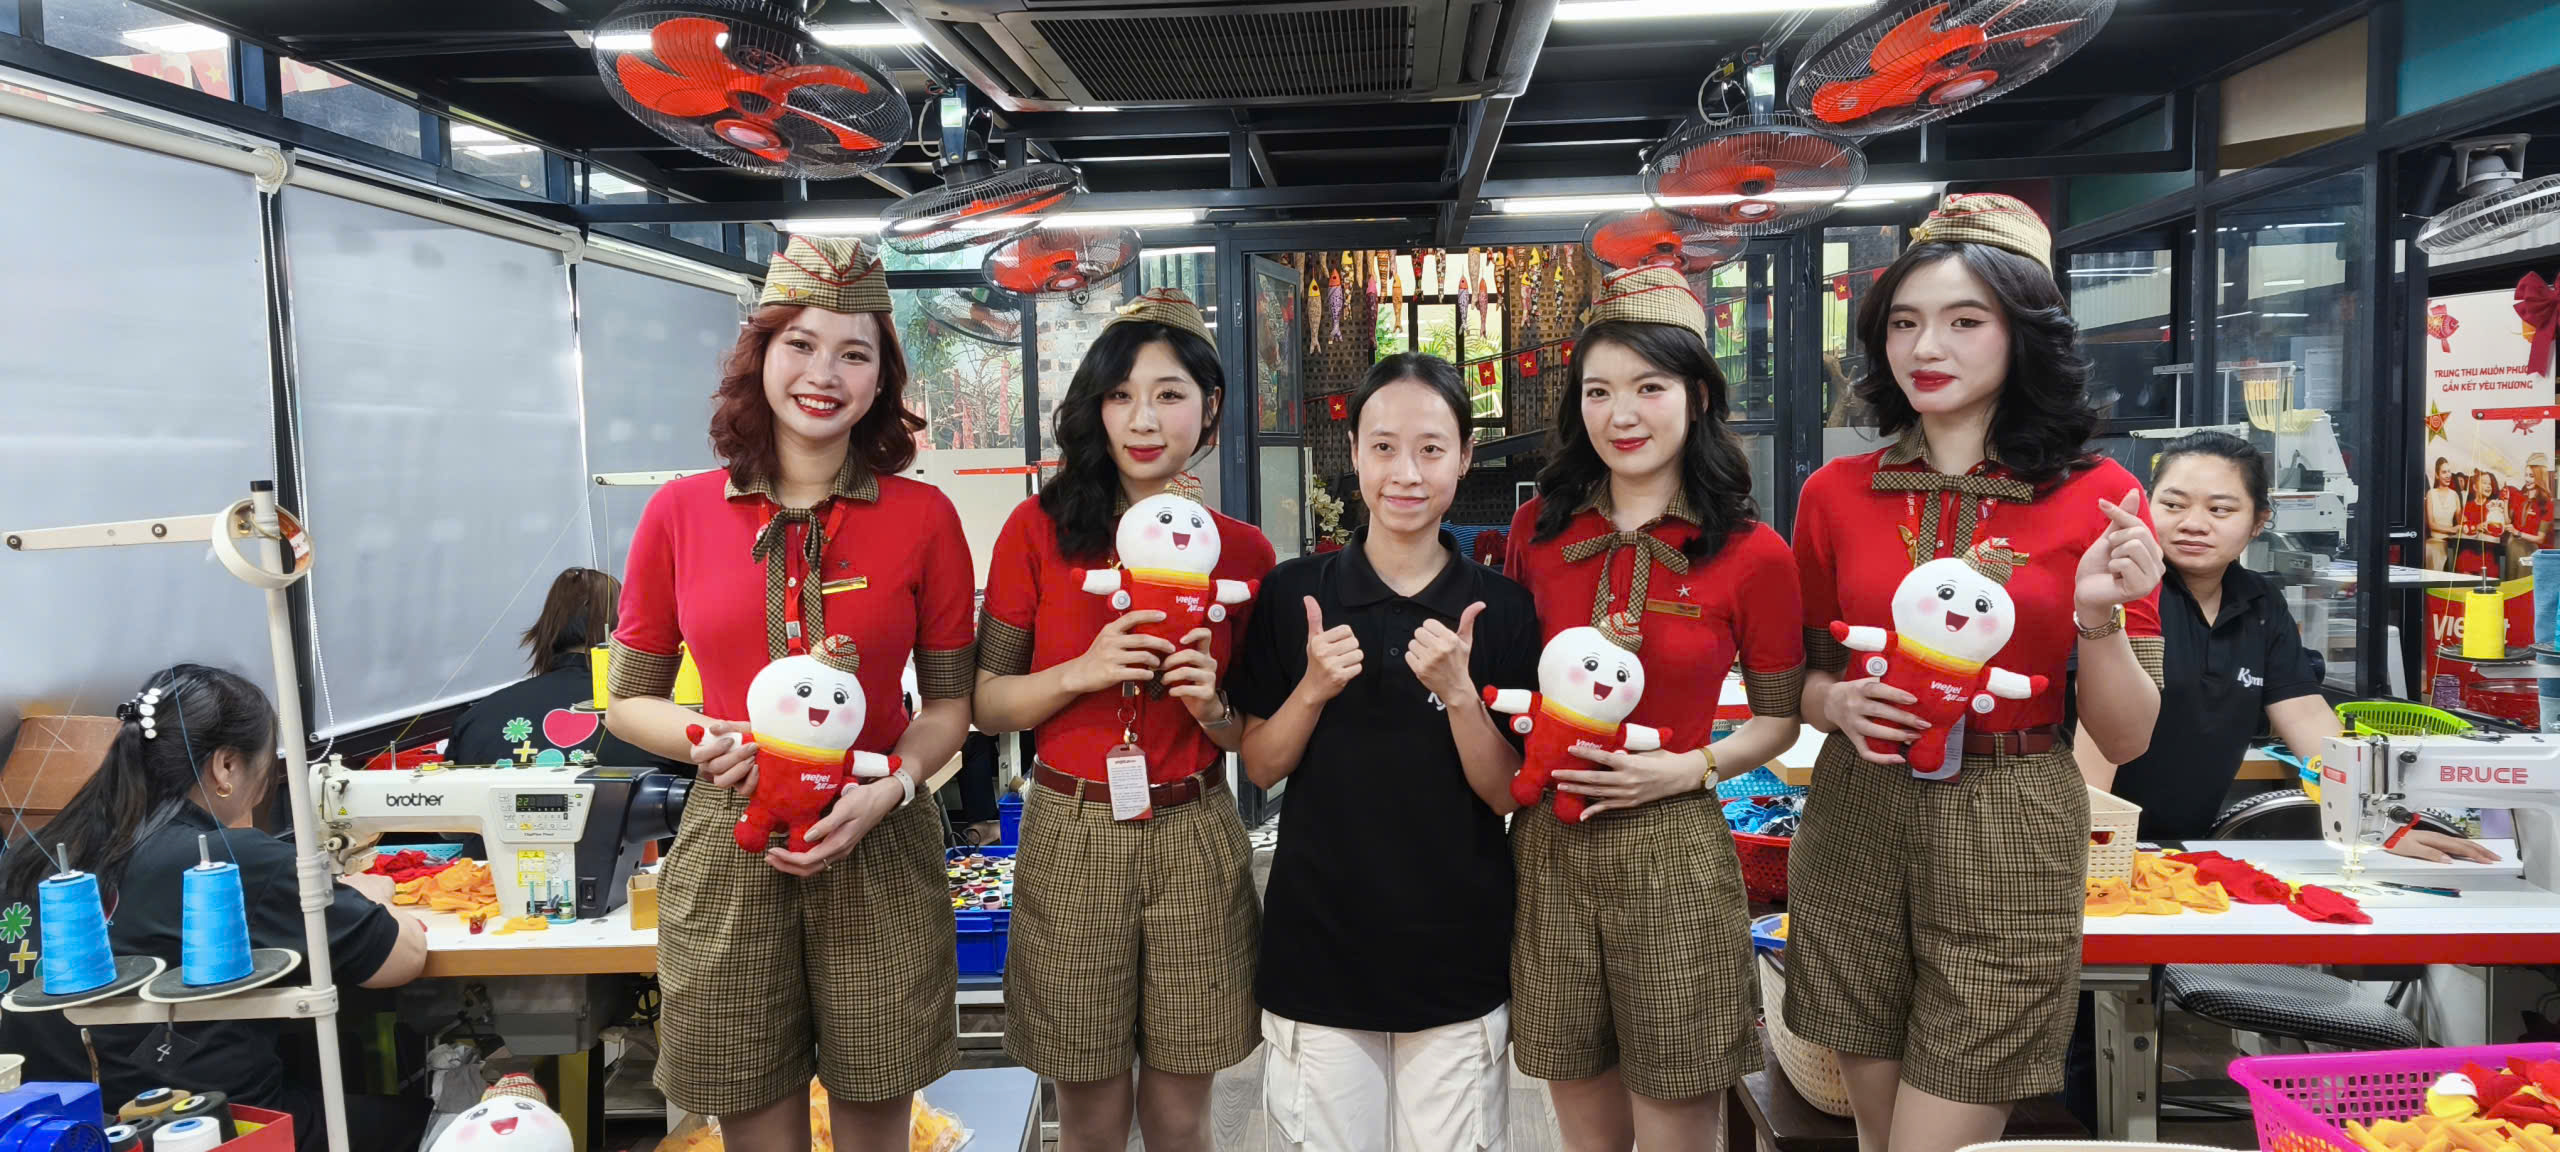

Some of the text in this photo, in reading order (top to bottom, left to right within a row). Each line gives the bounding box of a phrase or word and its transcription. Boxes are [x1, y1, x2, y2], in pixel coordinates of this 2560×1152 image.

[2434, 368, 2460, 378] TRUNG
[2461, 367, 2478, 377] THU
[2440, 765, 2529, 784] BRUCE
[386, 792, 444, 807] brother
